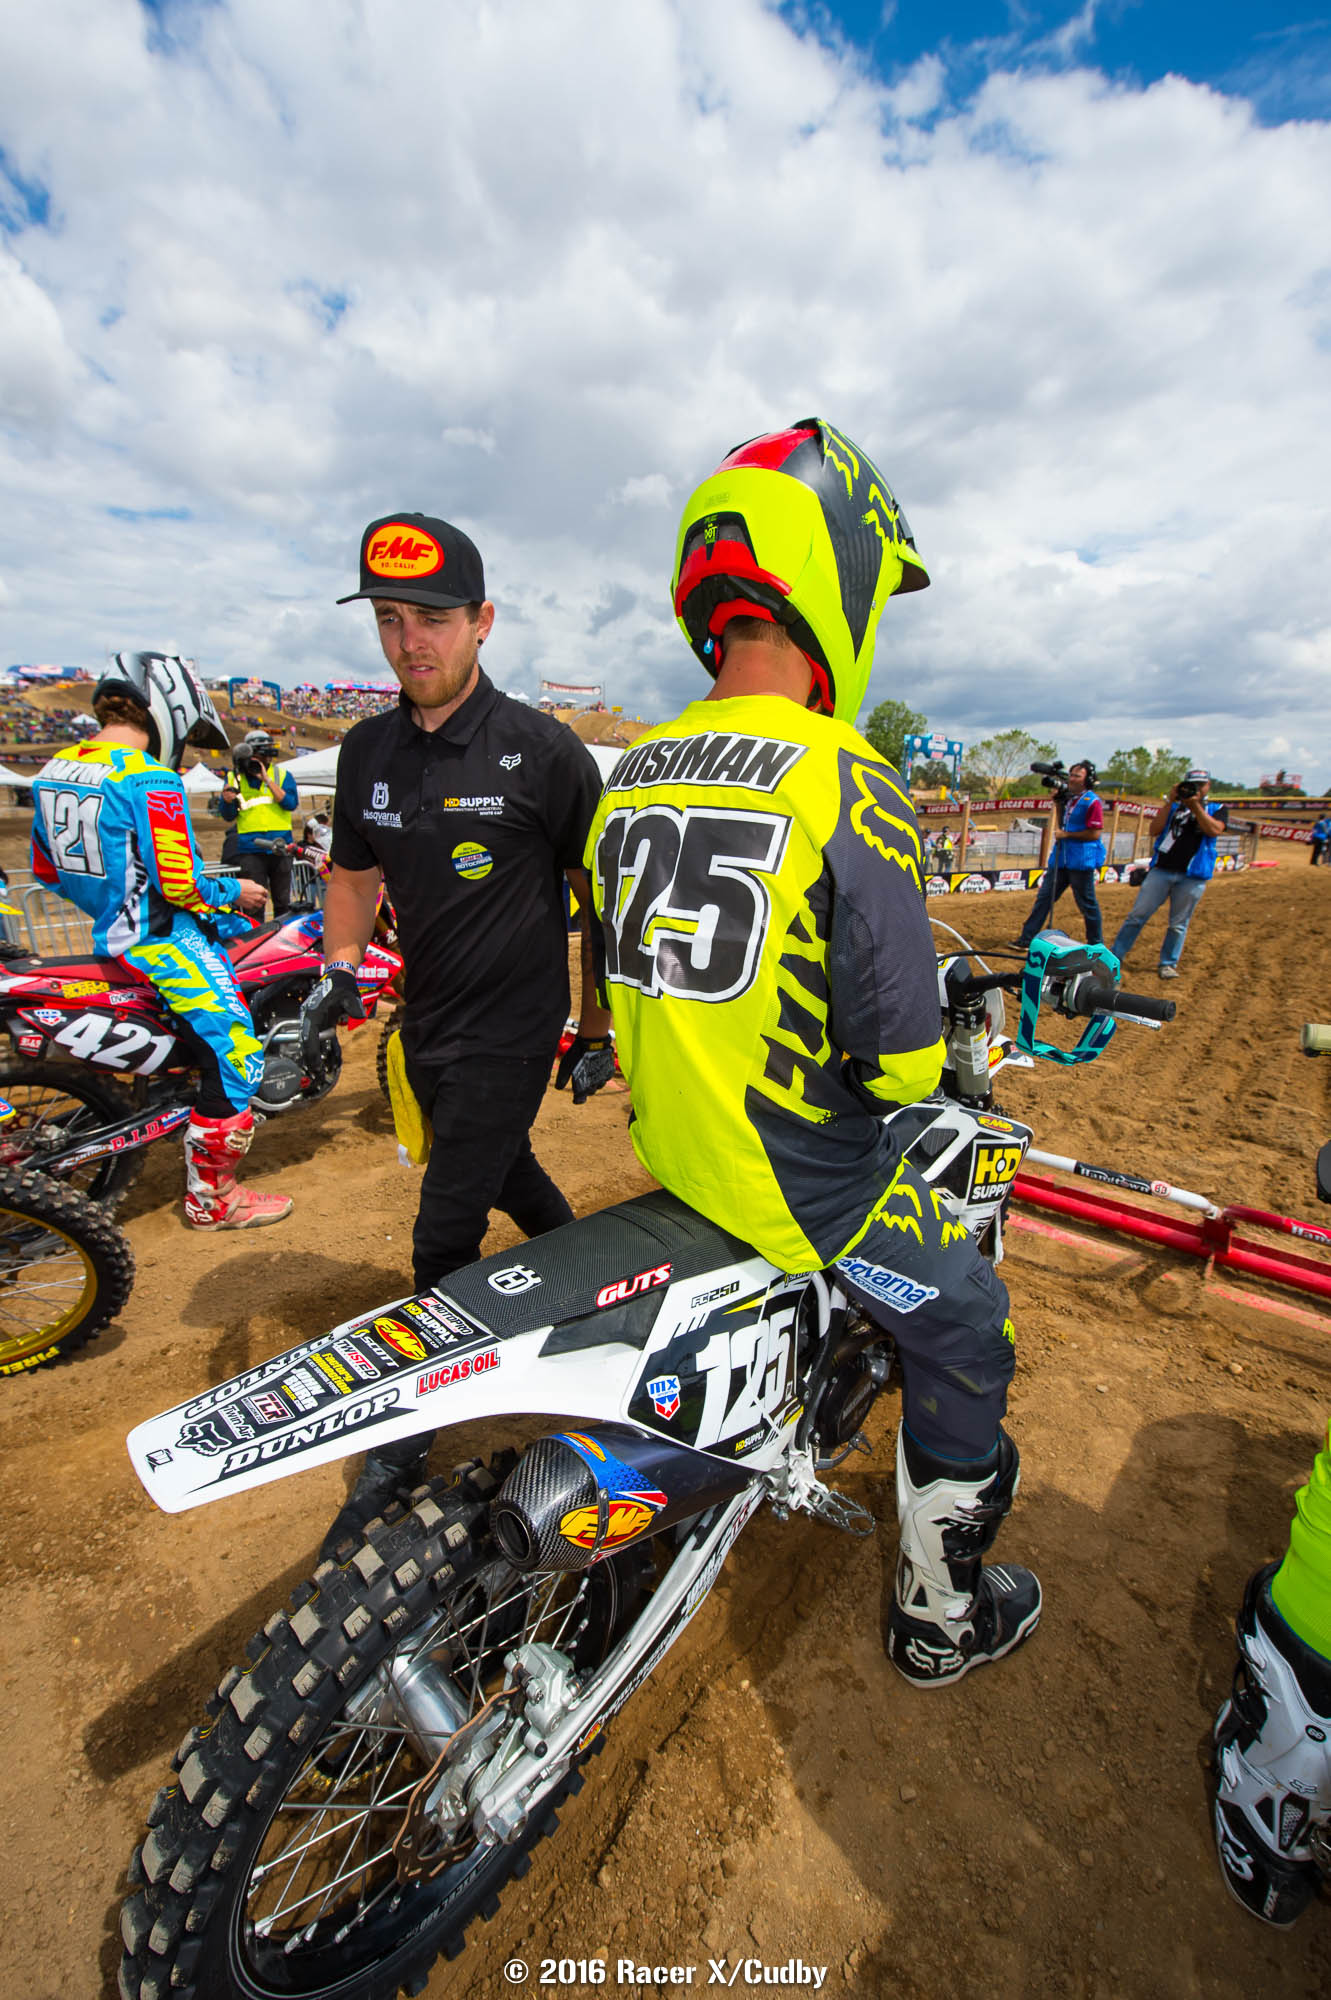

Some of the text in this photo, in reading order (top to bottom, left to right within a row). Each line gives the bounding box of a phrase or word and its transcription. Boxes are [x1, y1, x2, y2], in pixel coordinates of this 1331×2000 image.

[370, 536, 433, 560] FMF
[605, 734, 801, 789] HOSIMAN
[363, 809, 401, 822] Husqvarna
[999, 800, 1022, 809] LUCAS
[1262, 826, 1291, 838] UCAS
[597, 804, 792, 1003] 125
[54, 1012, 176, 1076] 421
[974, 1148, 1022, 1185] HD
[972, 1183, 1008, 1200] SUPPL
[597, 1263, 671, 1308] GUTS
[363, 1336, 400, 1368] SCOTT
[373, 1319, 428, 1358] FMF
[321, 1353, 355, 1382] Factory
[334, 1340, 378, 1377] TWISTED
[418, 1351, 499, 1396] LUCAS OIL
[694, 1306, 797, 1450] 125
[222, 1389, 399, 1475] DUNLOP
[559, 1506, 656, 1541] FMF
